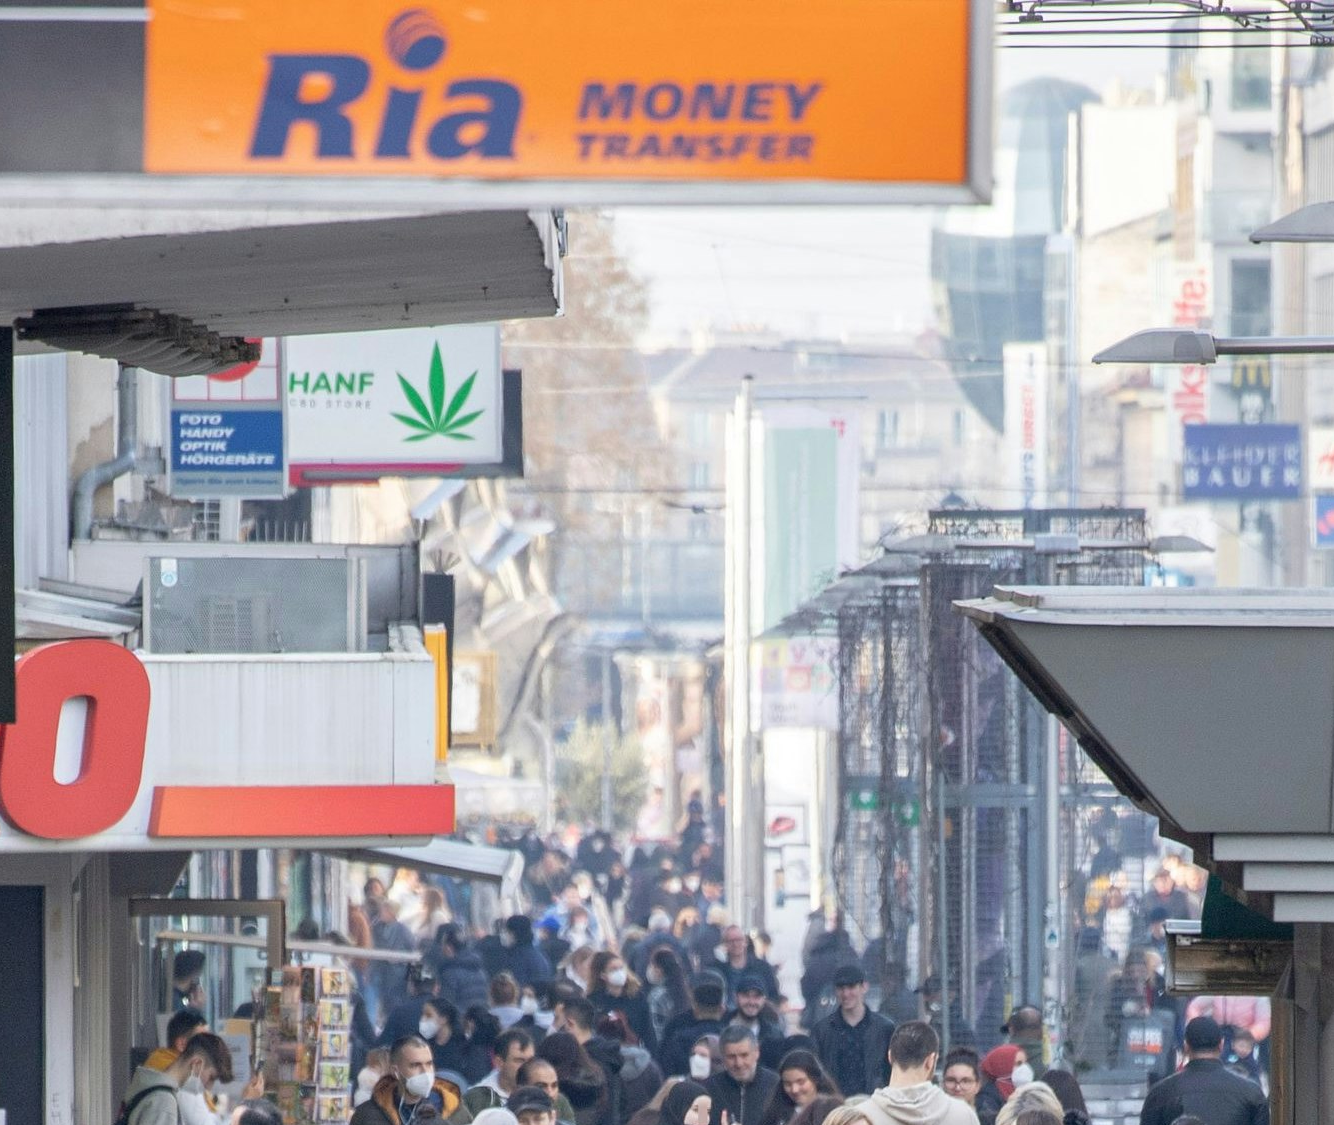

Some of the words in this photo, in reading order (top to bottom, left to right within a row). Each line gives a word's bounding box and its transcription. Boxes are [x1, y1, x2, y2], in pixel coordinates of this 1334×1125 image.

[246, 8, 524, 161] Ria
[577, 80, 824, 123] MONEY
[576, 133, 815, 163] TRANSFER
[289, 371, 375, 395] HANF
[289, 398, 316, 409] CBD
[325, 399, 372, 410] STORE
[179, 413, 222, 426] FOTO
[179, 427, 235, 439] HANDY
[179, 440, 227, 452] OPTIK
[180, 452, 276, 465] HÖRGERÄTE
